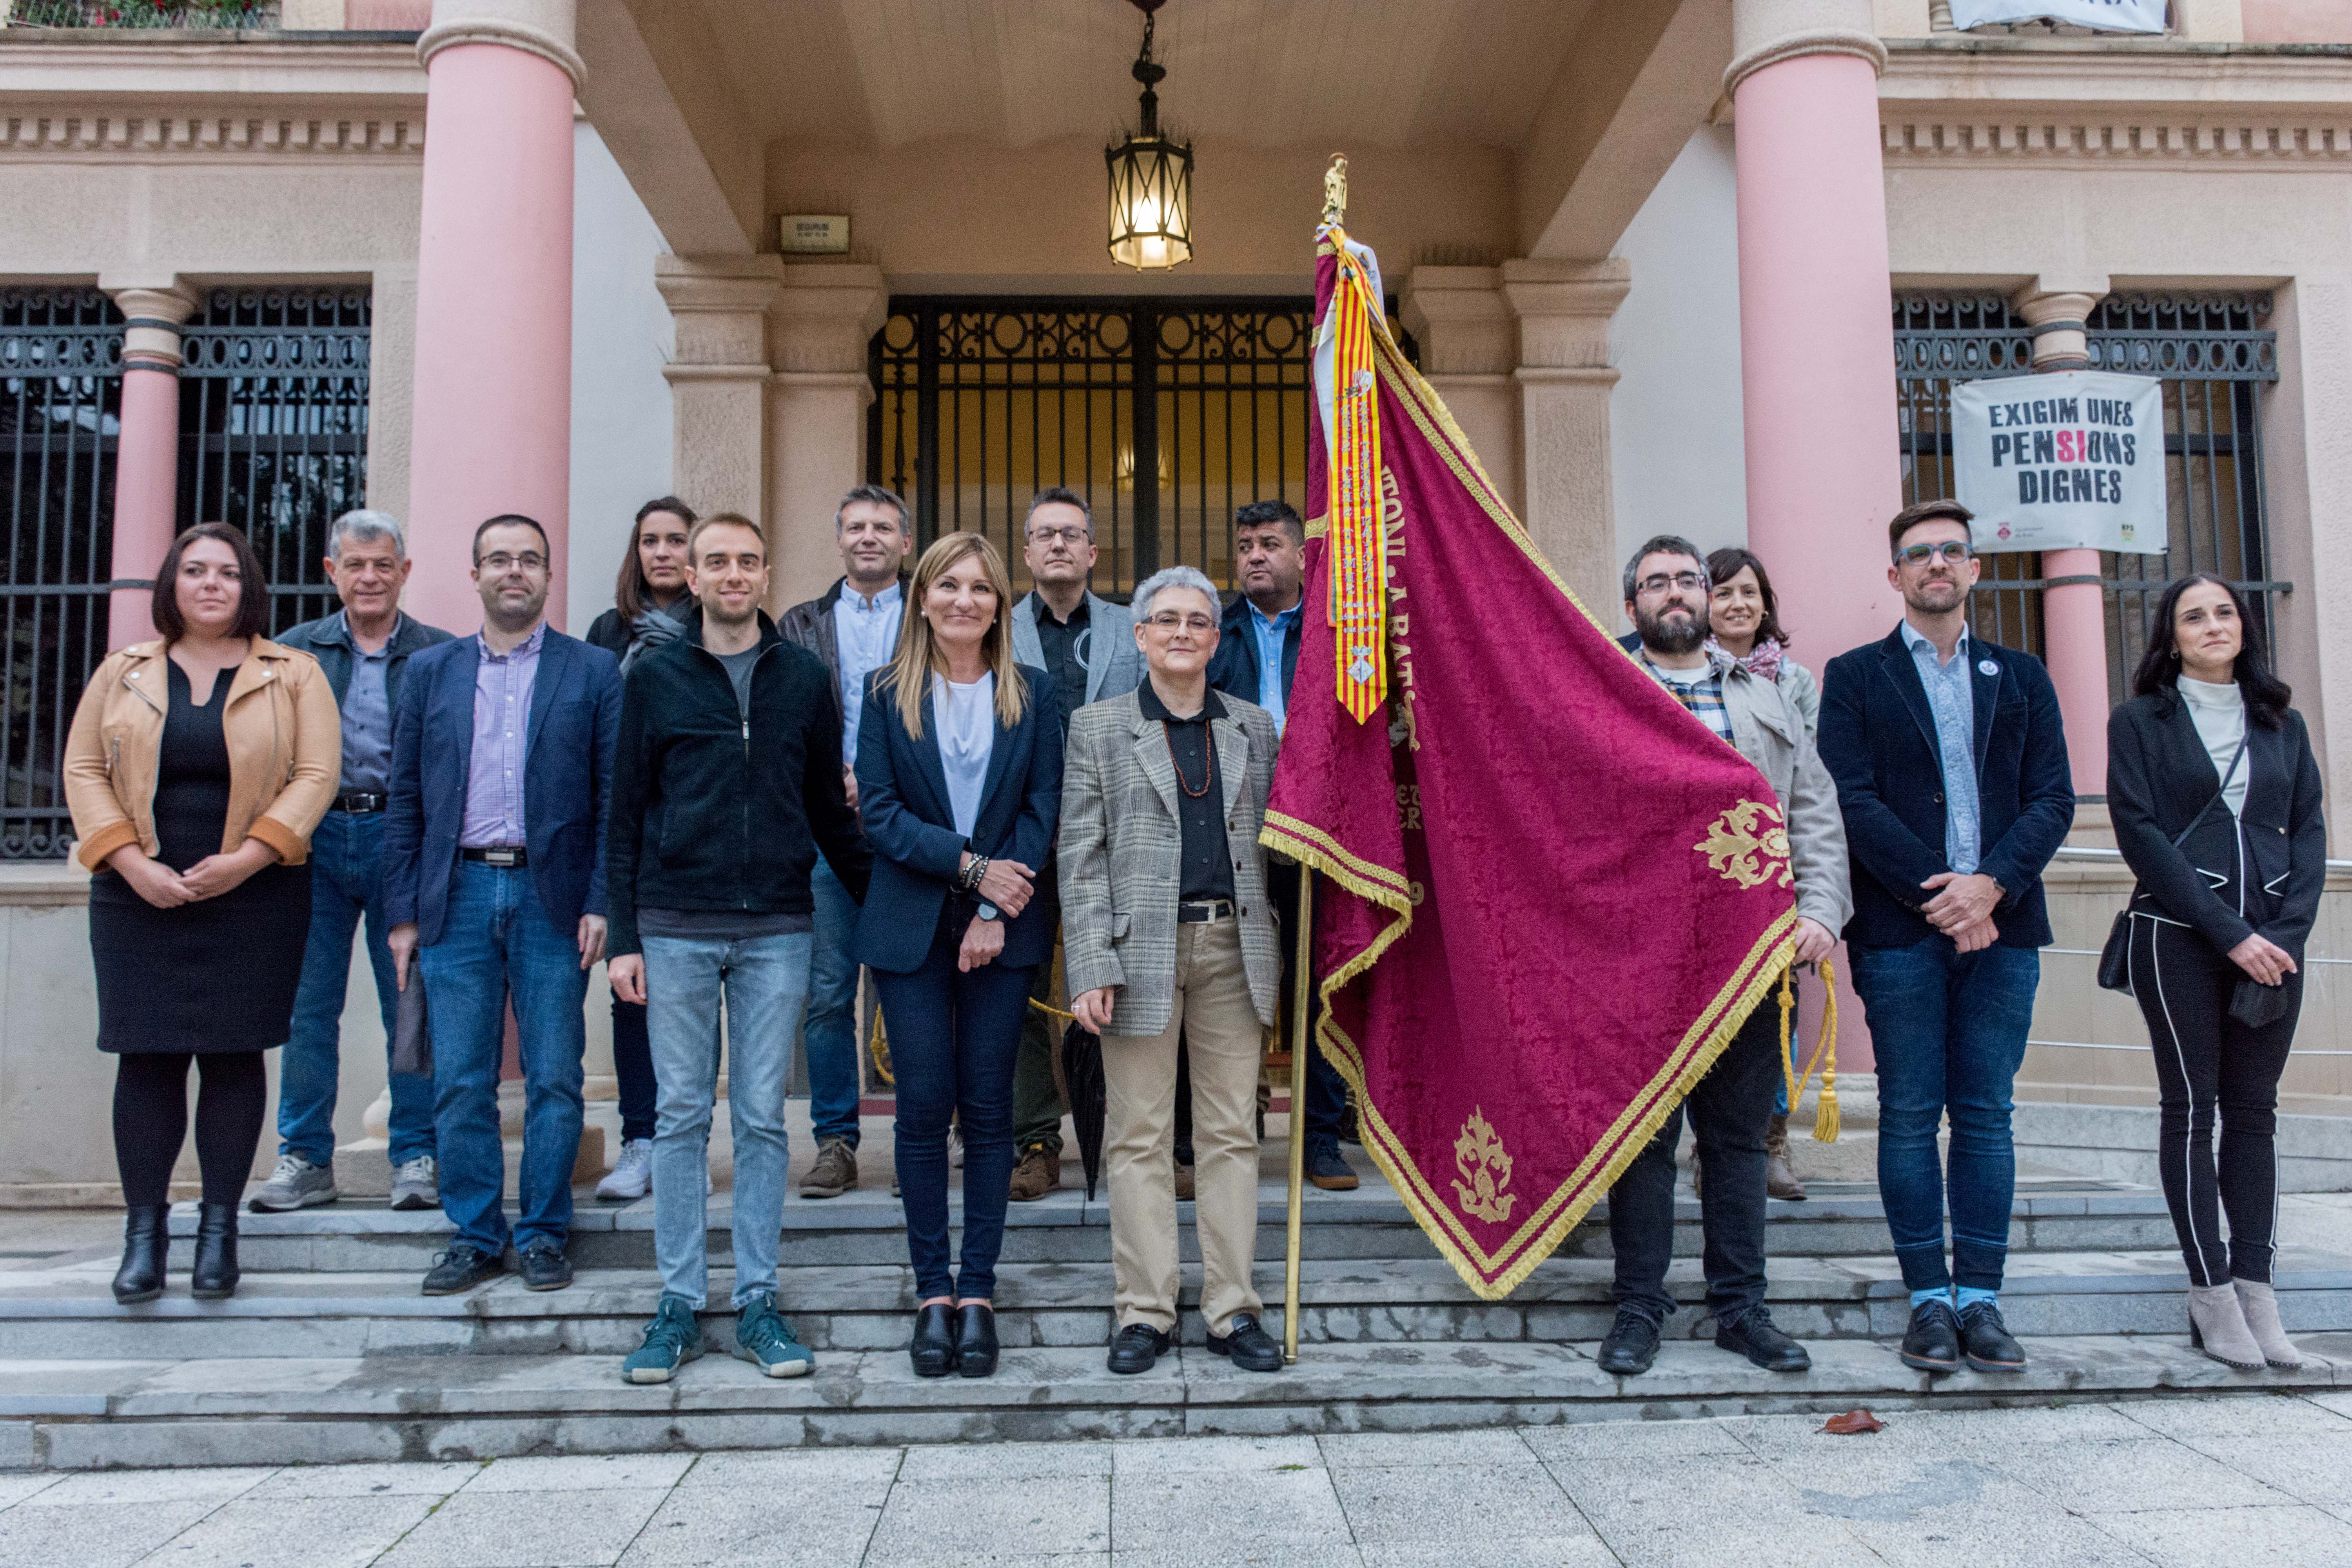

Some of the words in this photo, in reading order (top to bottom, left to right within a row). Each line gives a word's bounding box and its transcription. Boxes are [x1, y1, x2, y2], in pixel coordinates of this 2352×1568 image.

[1988, 397, 2079, 428] EXIGIM
[2087, 397, 2134, 426] UNES
[1992, 430, 2136, 467] PENSIONS
[2018, 469, 2122, 504] DIGNES
